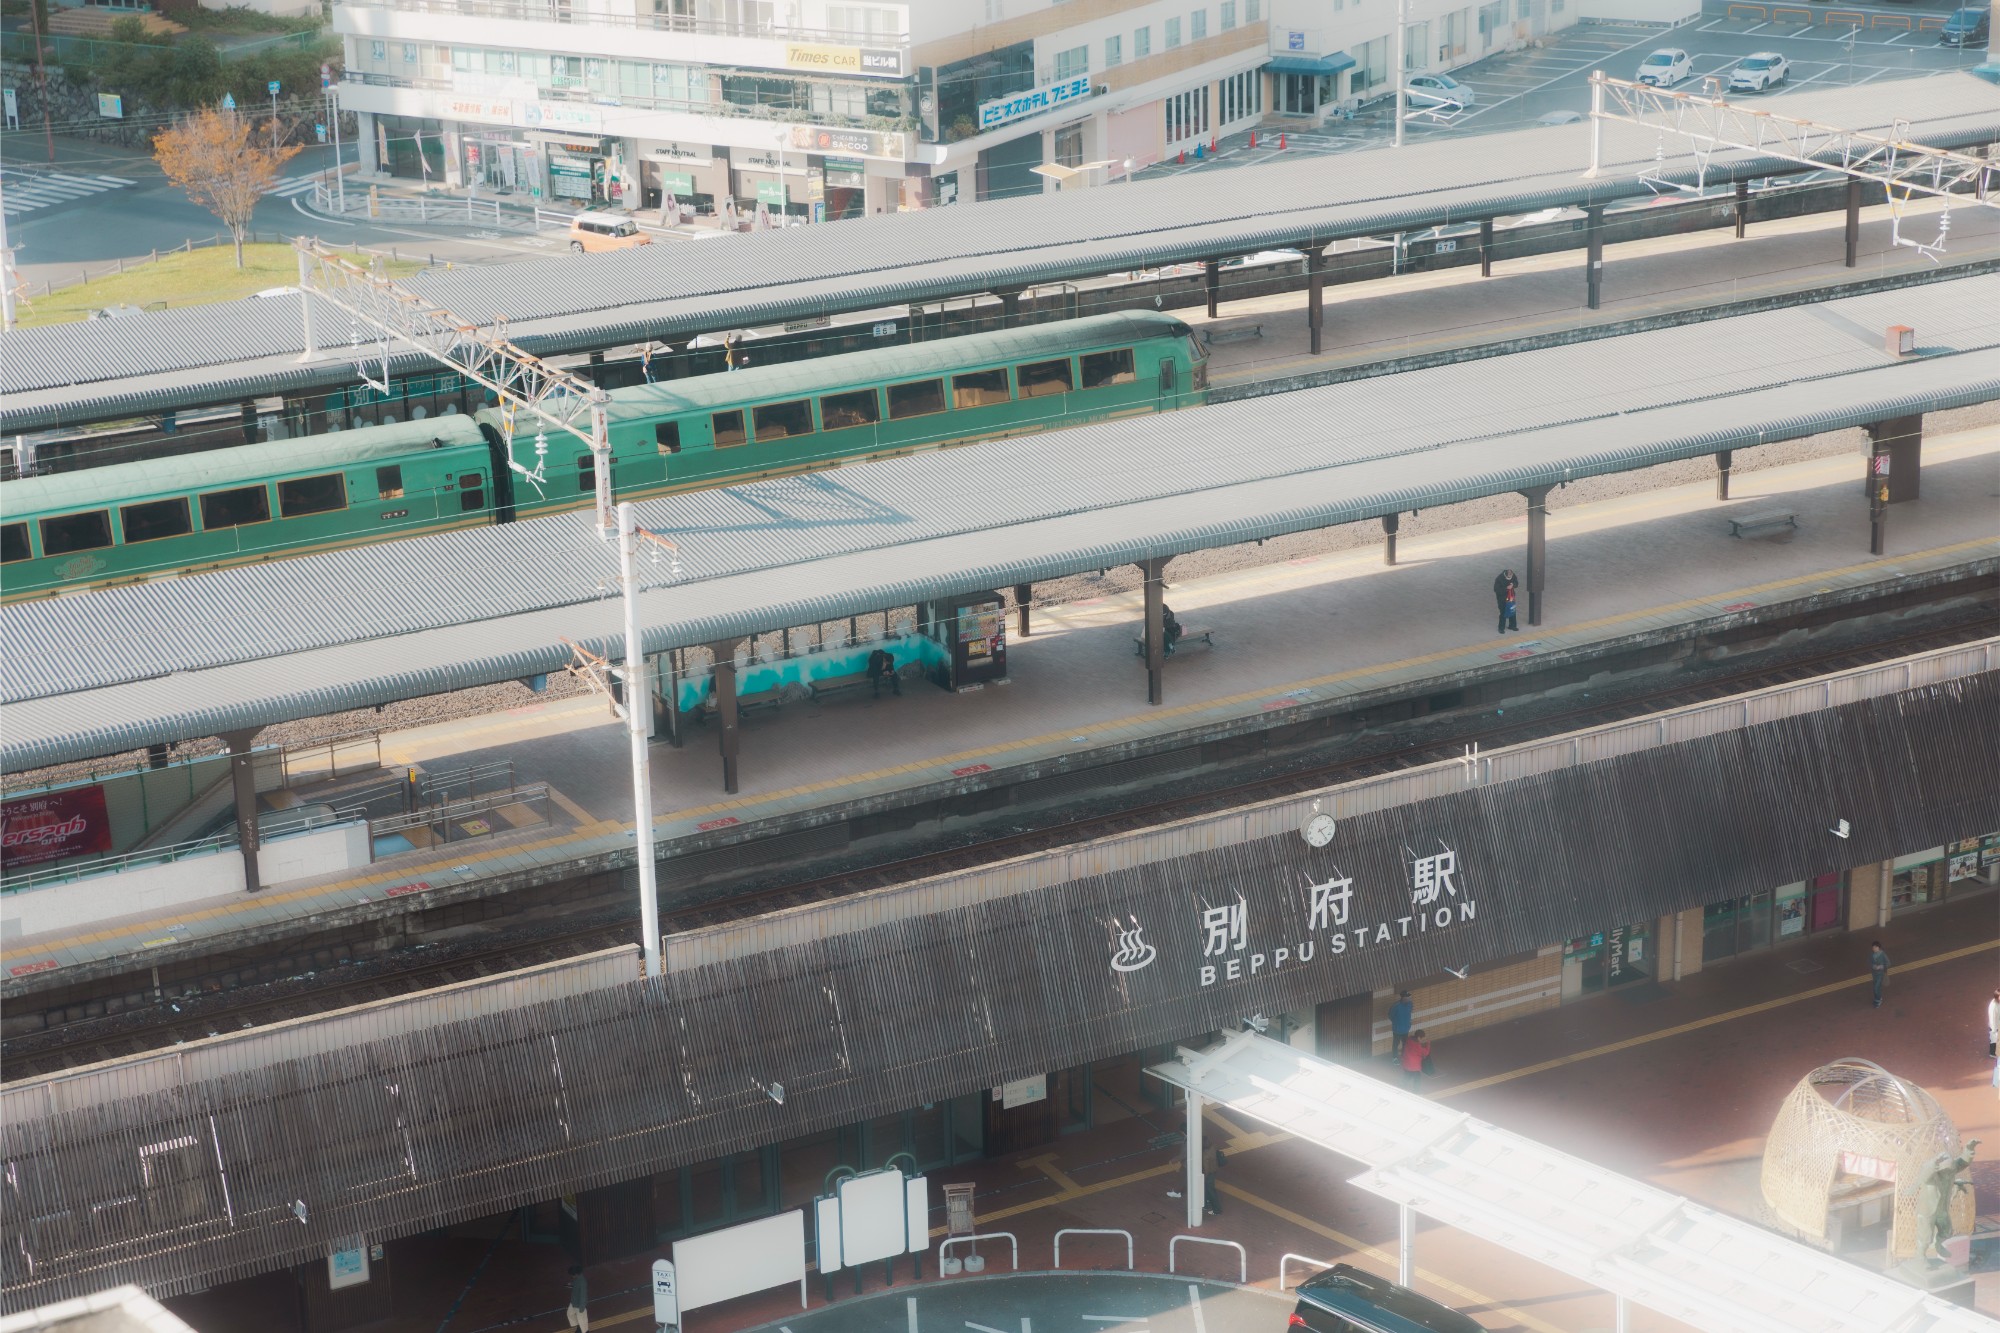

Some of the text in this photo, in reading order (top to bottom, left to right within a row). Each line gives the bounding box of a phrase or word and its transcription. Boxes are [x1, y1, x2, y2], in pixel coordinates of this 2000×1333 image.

[789, 48, 857, 66] Times CAR
[983, 92, 1049, 125] ビジネスホテル
[832, 141, 868, 151] SA-COO
[655, 148, 671, 156] STAFF
[671, 149, 697, 159] NEUTRAL
[748, 157, 765, 165] STAFF
[30, 800, 48, 812] 別府
[1200, 900, 1477, 988] BEPPU STATION
